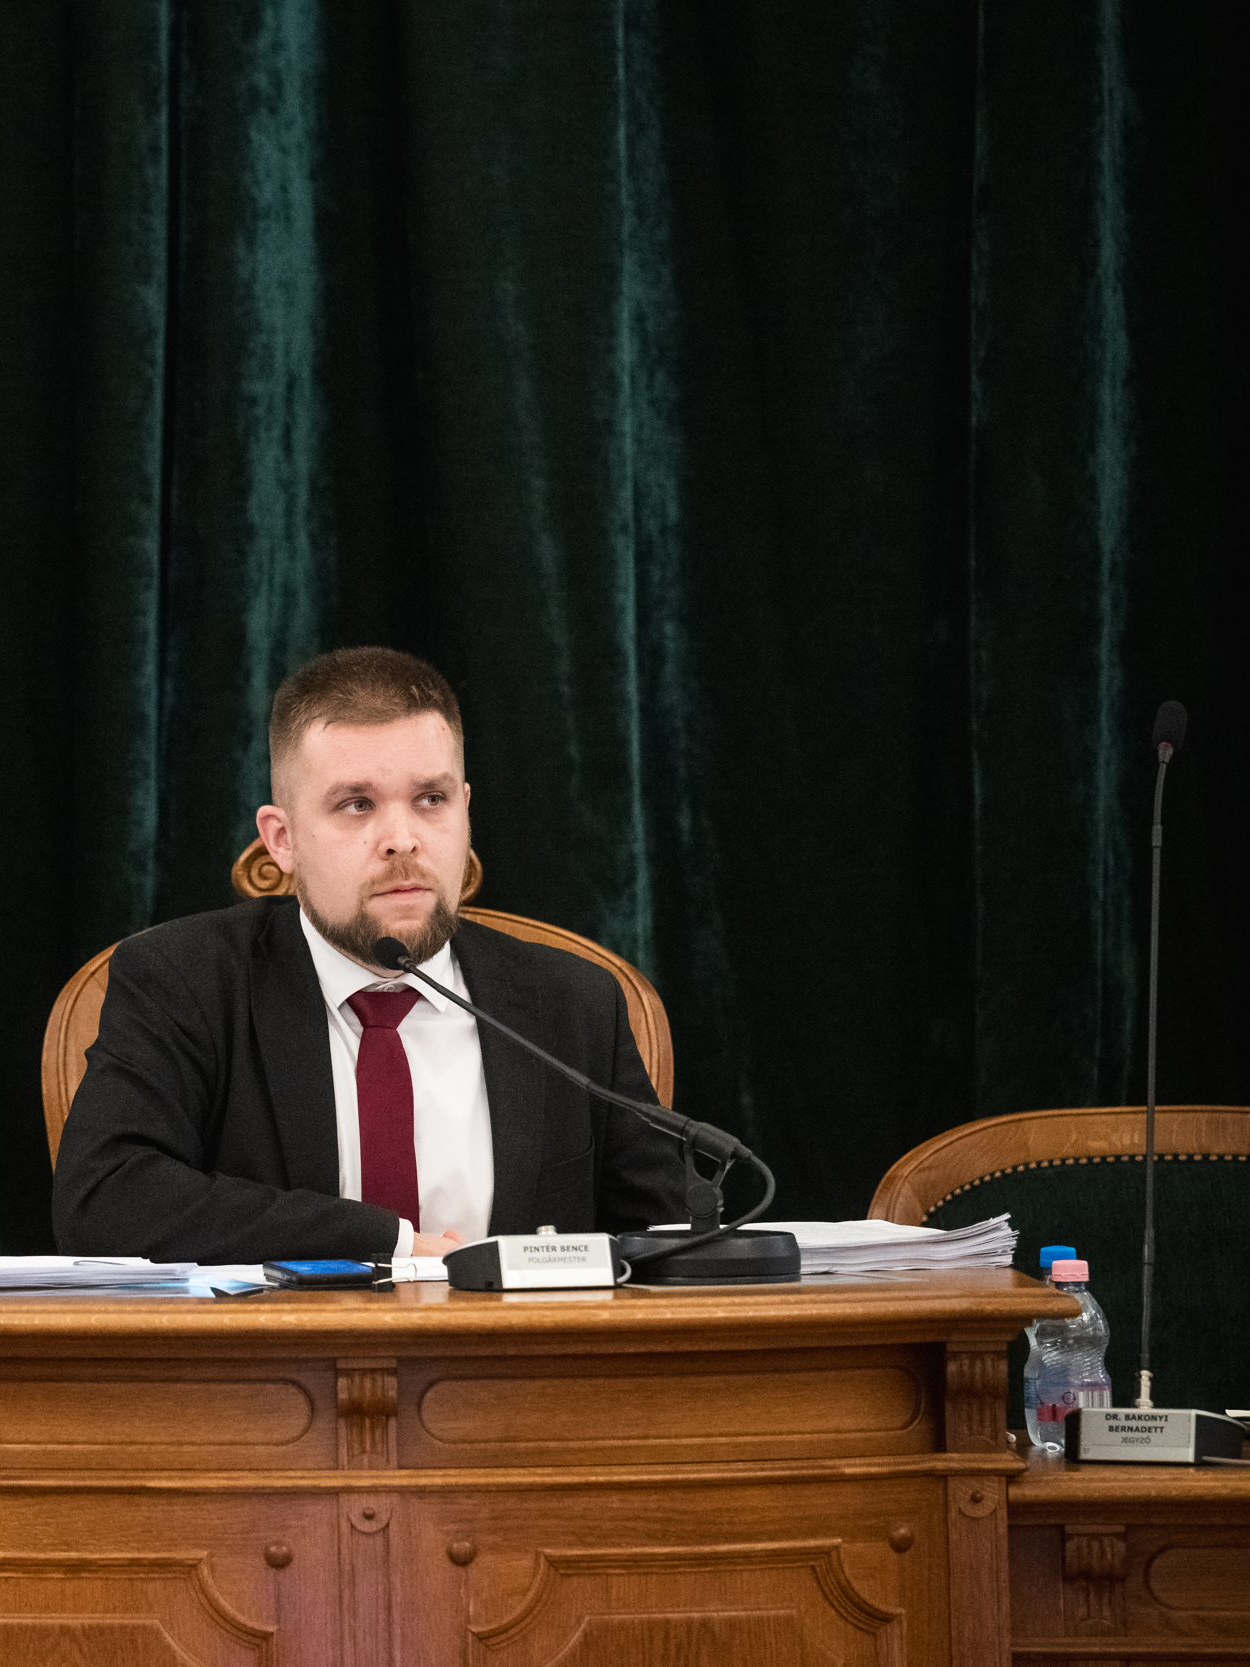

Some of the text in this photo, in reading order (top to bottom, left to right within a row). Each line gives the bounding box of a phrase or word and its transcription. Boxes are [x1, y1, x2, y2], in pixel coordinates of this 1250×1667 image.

[523, 1243, 589, 1253] PINTÉR BENCE
[528, 1255, 587, 1264] POLGÁRMESTER
[1105, 1413, 1168, 1422] DR. BAKONYI
[1108, 1425, 1165, 1433] BERNADETT
